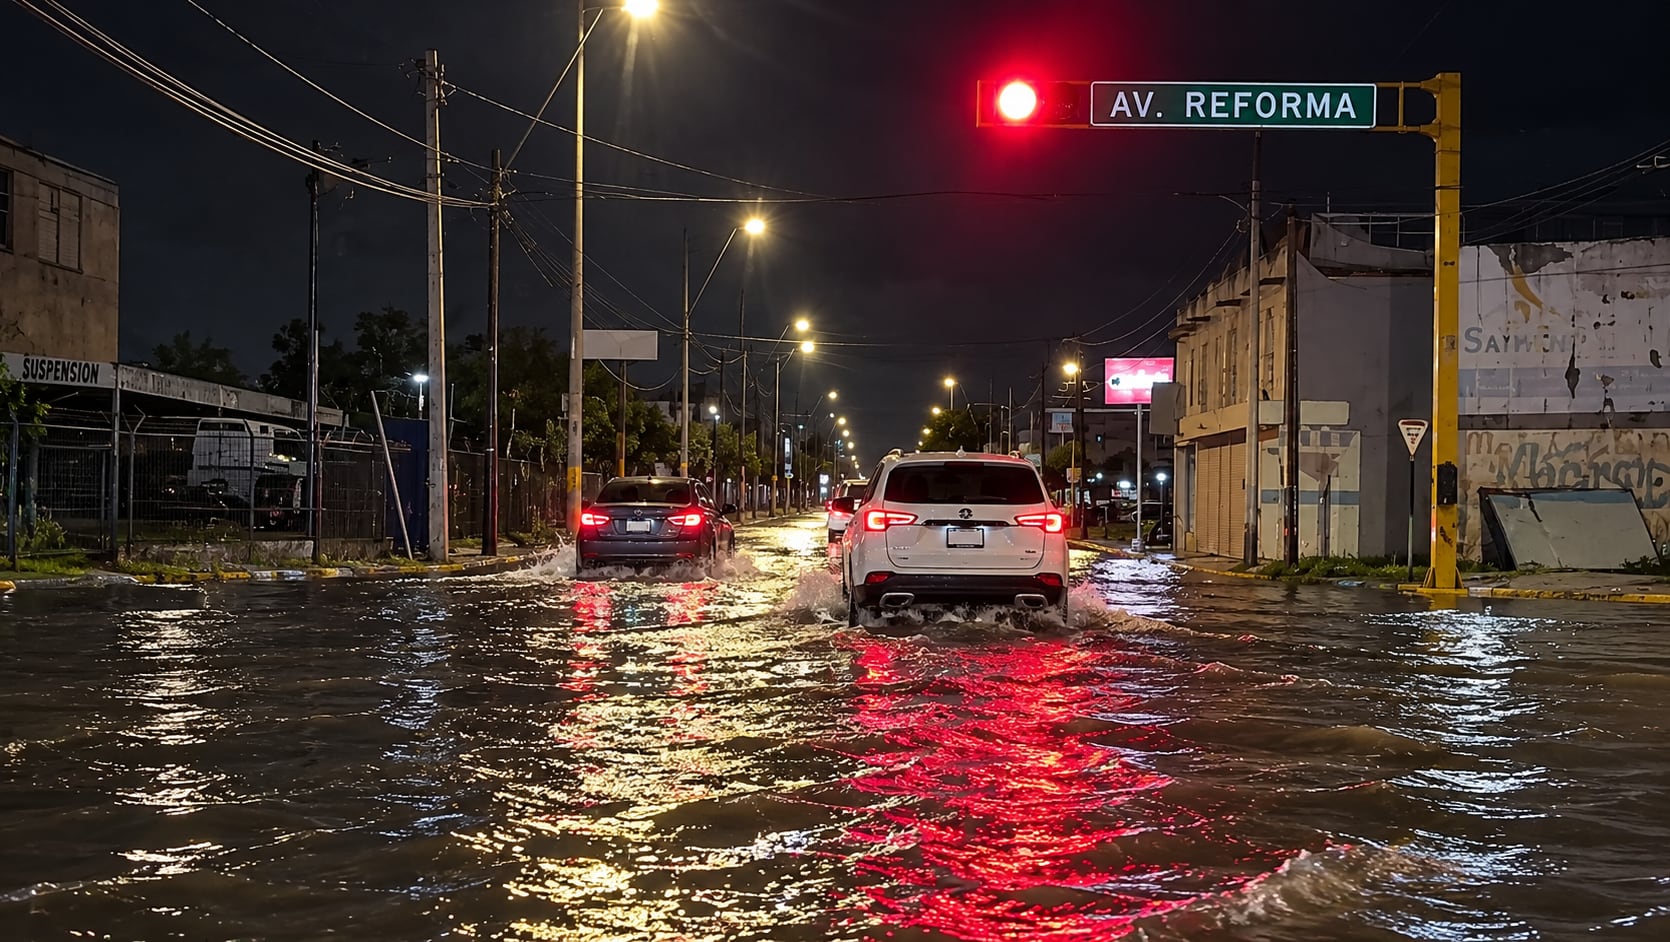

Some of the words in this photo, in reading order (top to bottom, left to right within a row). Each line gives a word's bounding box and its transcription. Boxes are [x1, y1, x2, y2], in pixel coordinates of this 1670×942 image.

[1110, 91, 1163, 118] AV.
[1185, 91, 1358, 119] REFORMA
[22, 357, 100, 385] SUSPENSION
